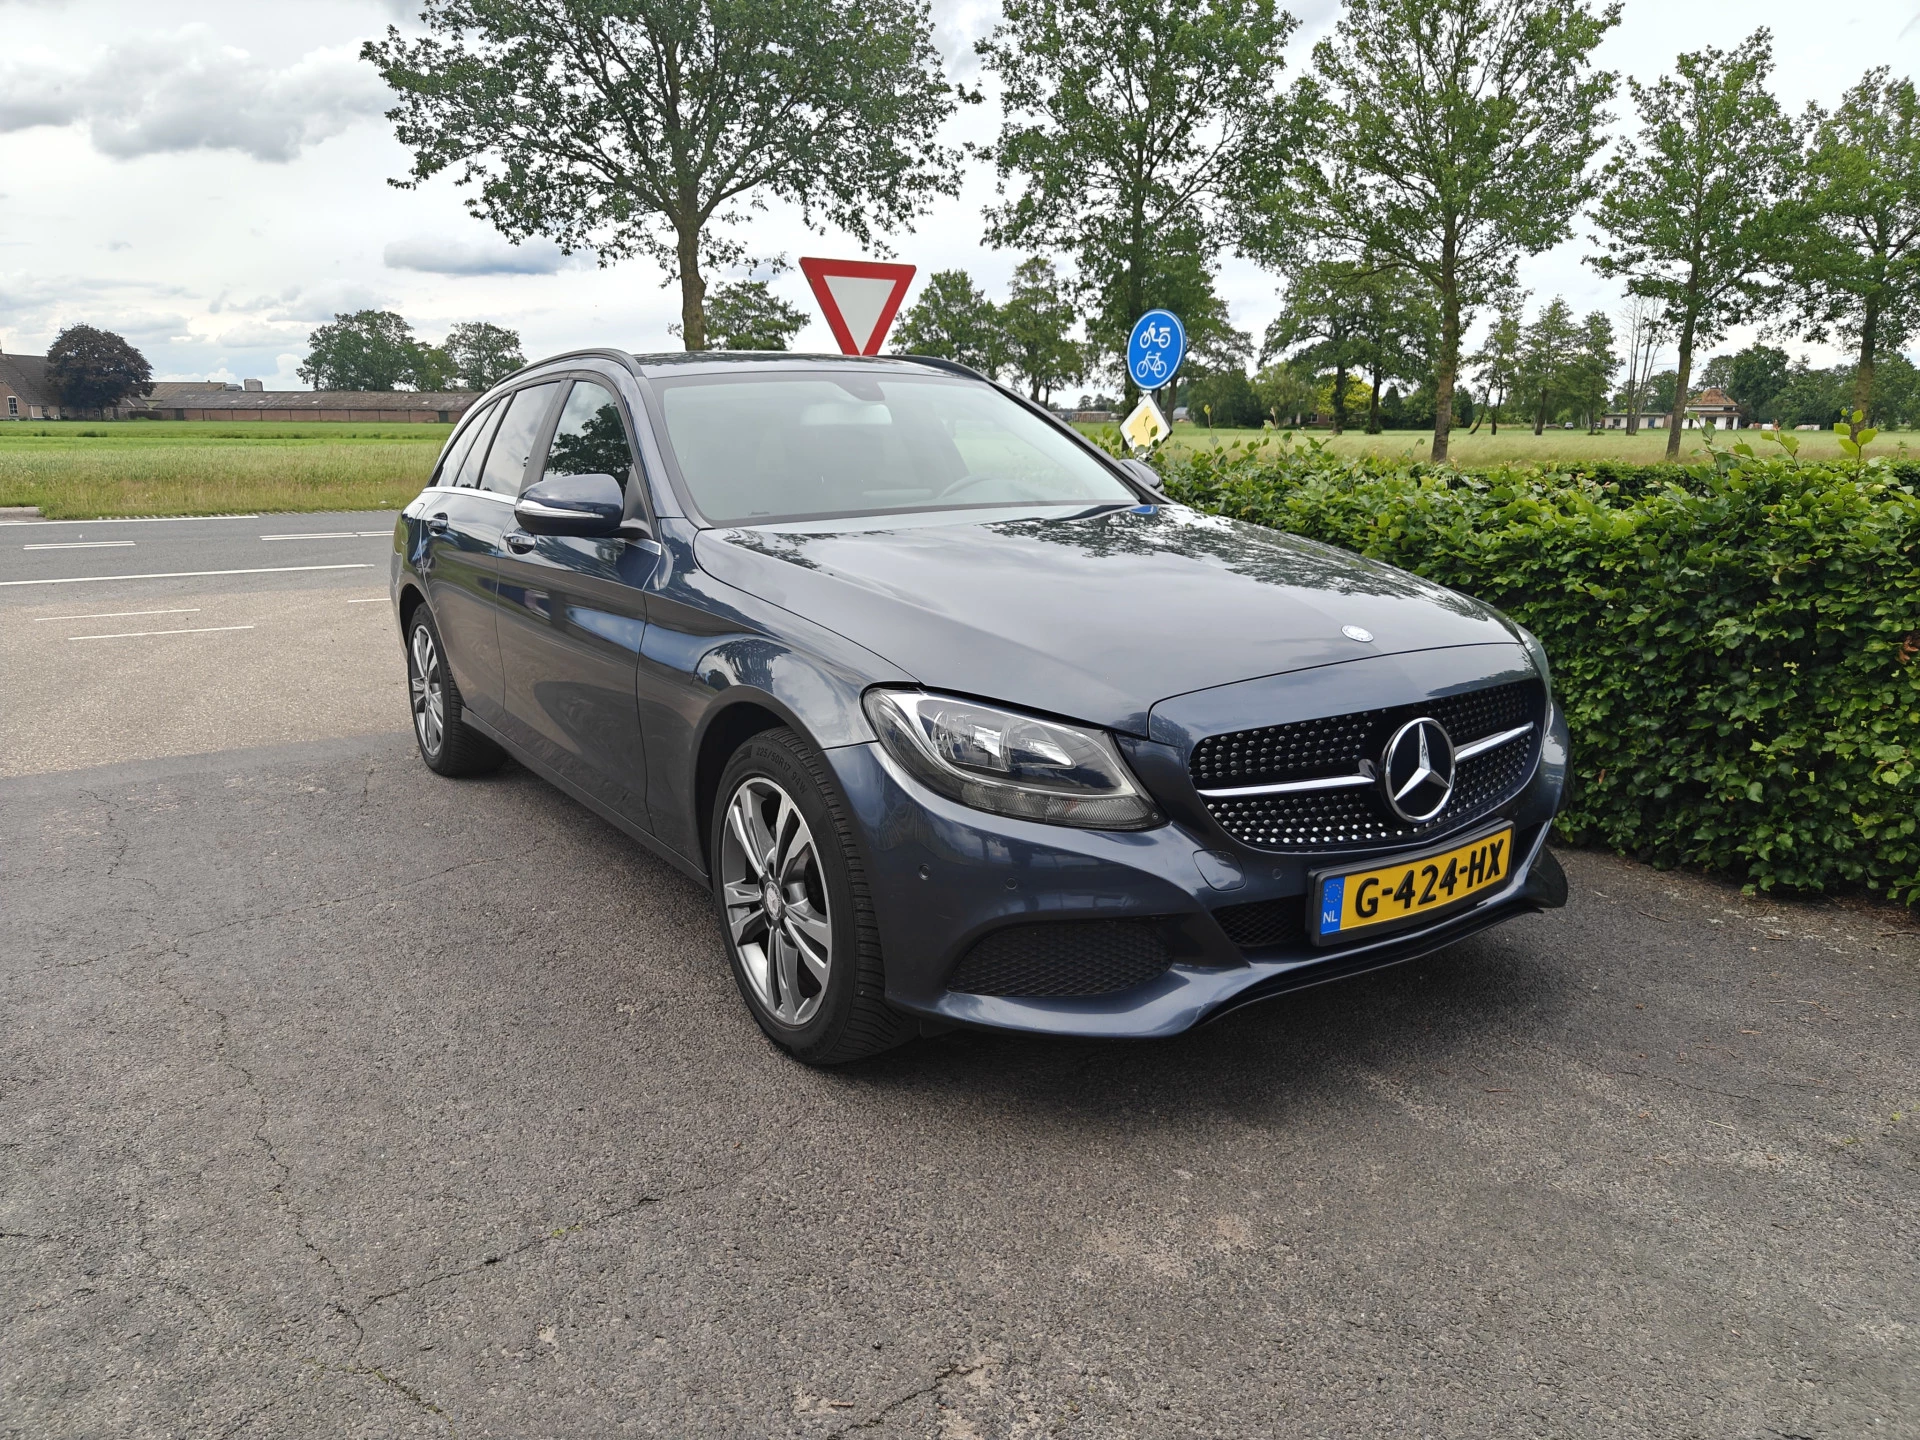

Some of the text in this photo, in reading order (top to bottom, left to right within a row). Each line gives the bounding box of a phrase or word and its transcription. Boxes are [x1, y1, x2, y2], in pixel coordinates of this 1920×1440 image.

[756, 746, 790, 772] 225/50R17
[1355, 838, 1504, 918] G-424-HX
[1322, 910, 1338, 924] NL
